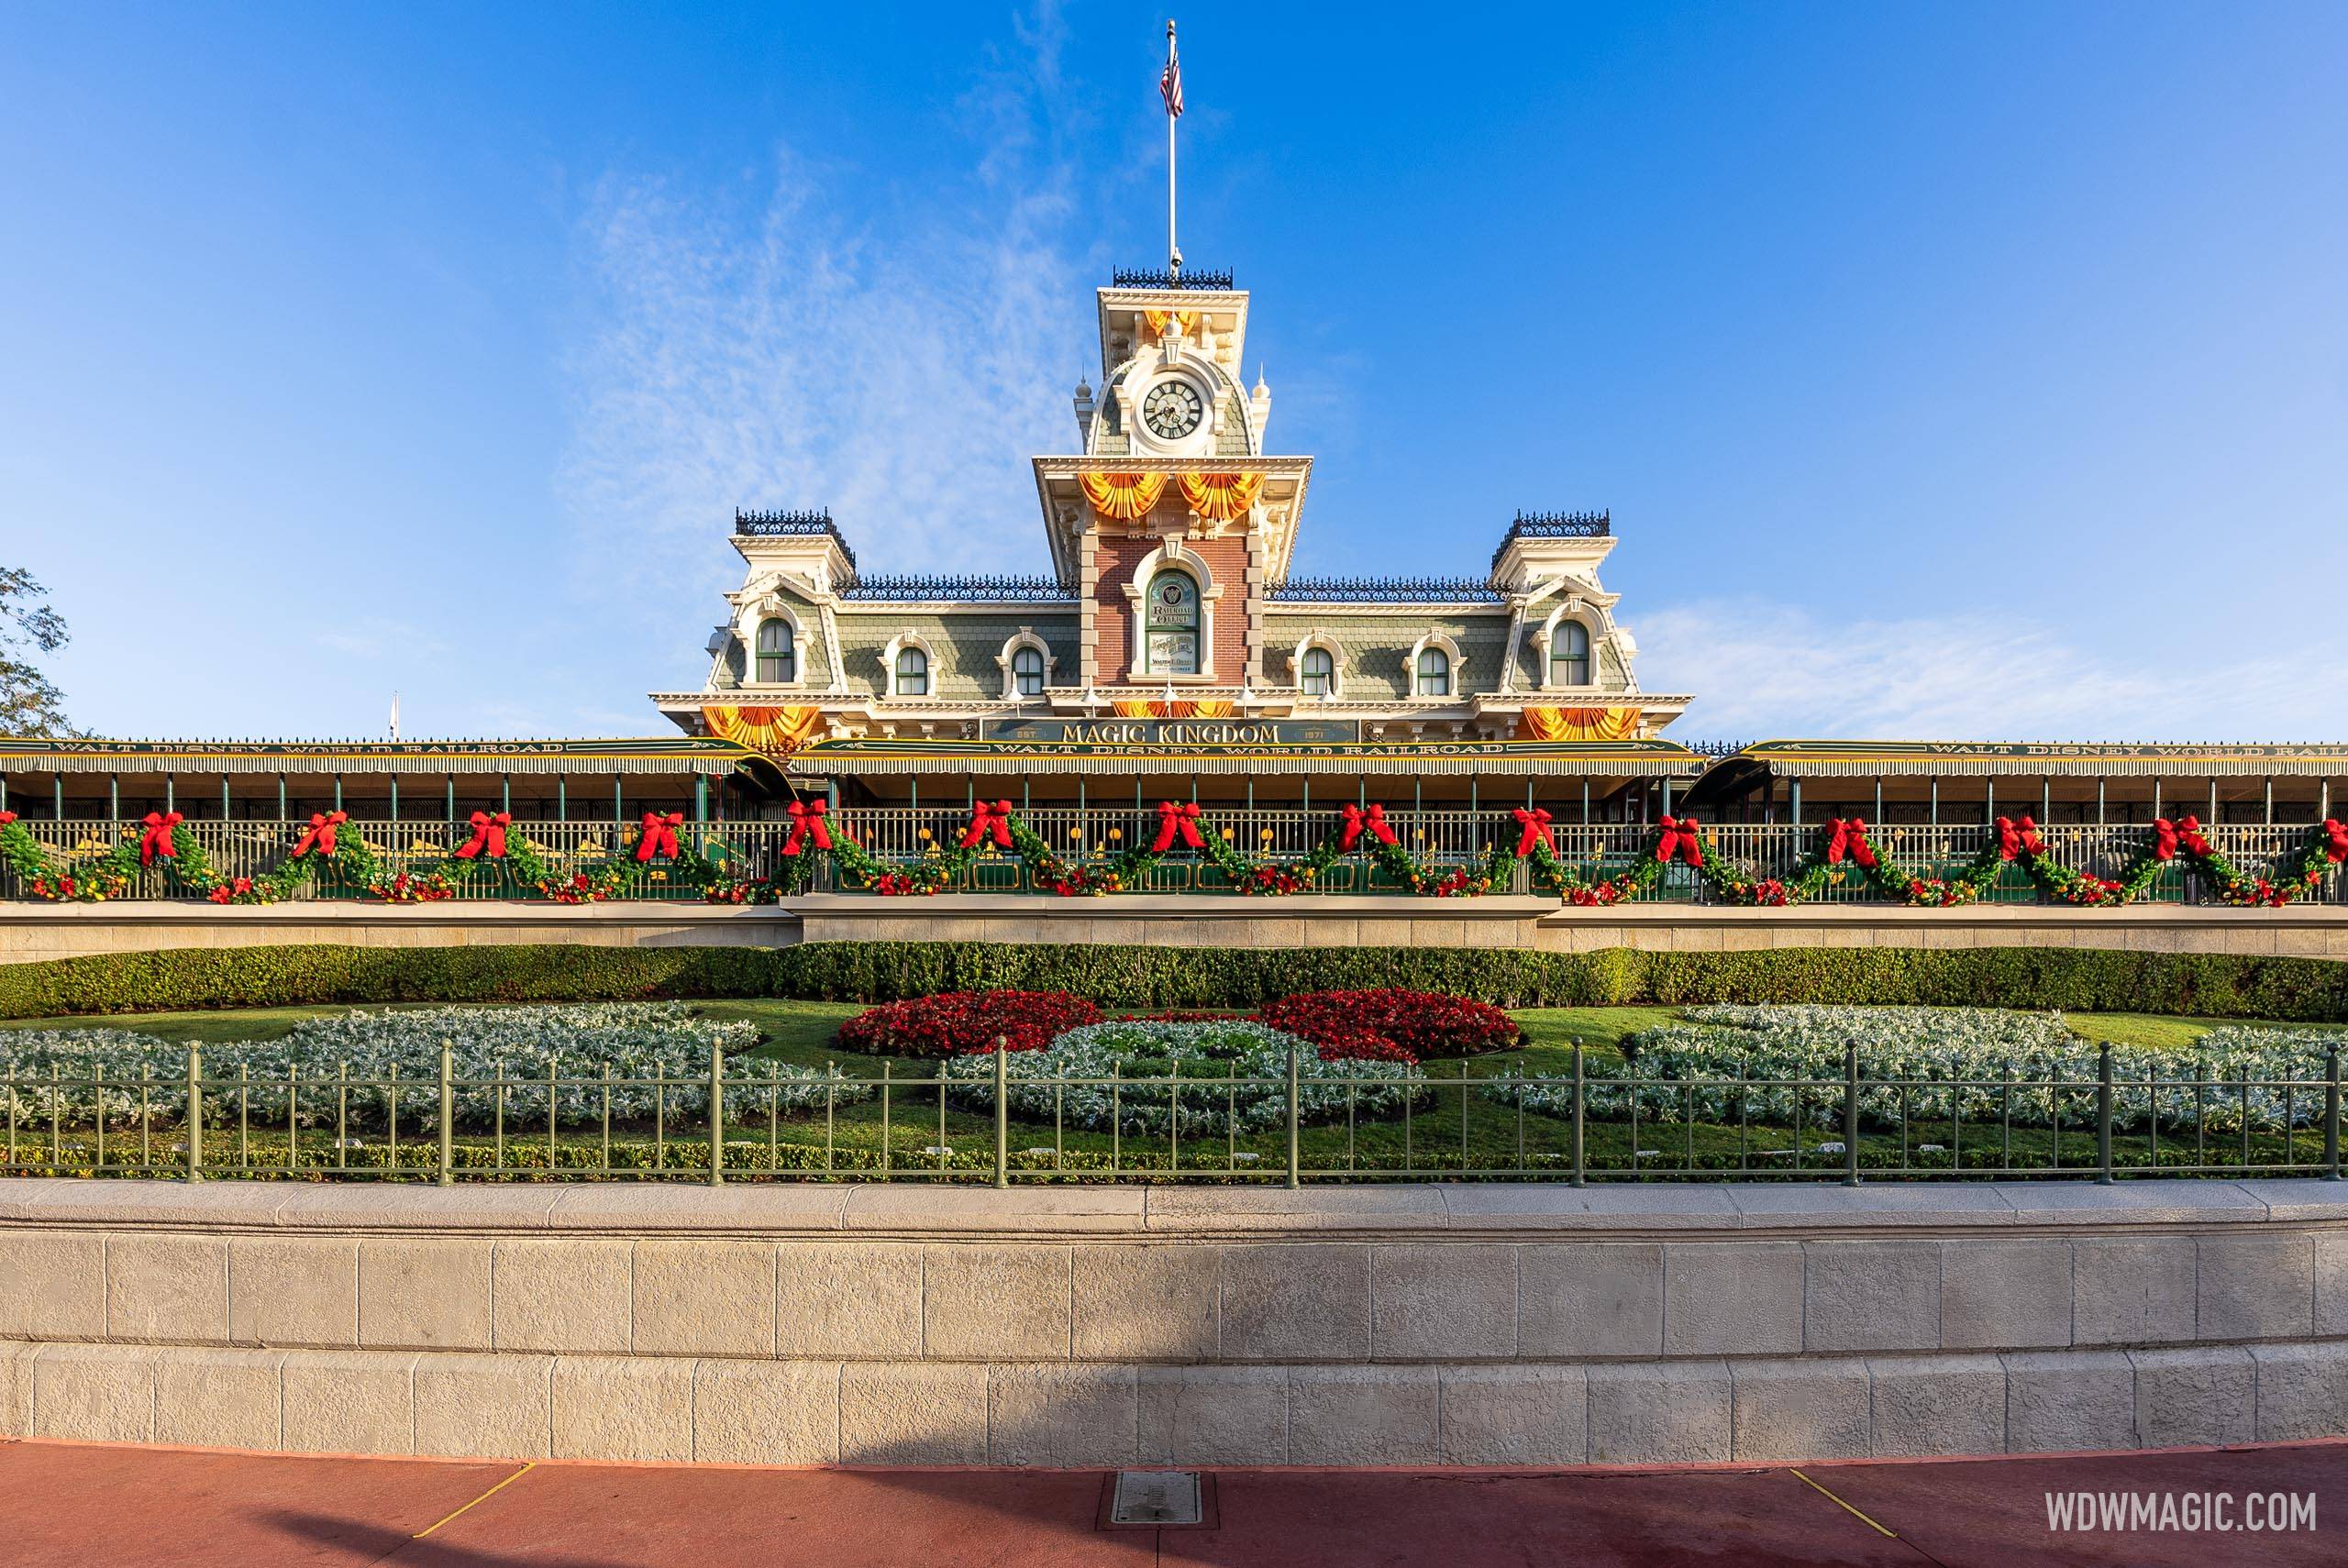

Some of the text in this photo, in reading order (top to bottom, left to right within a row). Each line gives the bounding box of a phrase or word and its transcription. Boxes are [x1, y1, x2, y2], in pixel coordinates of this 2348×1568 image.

[1153, 605, 1192, 614] RAILROAD
[1157, 615, 1190, 624] OFFICE
[1062, 724, 1280, 744] MAGIC KINGDOM
[1304, 731, 1324, 739] 1971
[54, 743, 137, 753] WALT
[151, 745, 269, 753] DISNEY
[403, 744, 563, 753] RAILROAD
[994, 745, 1078, 754] WALT
[1343, 745, 1503, 755] RAILROAD
[1930, 745, 2348, 756] WALT DISNEY WORLD RAIL
